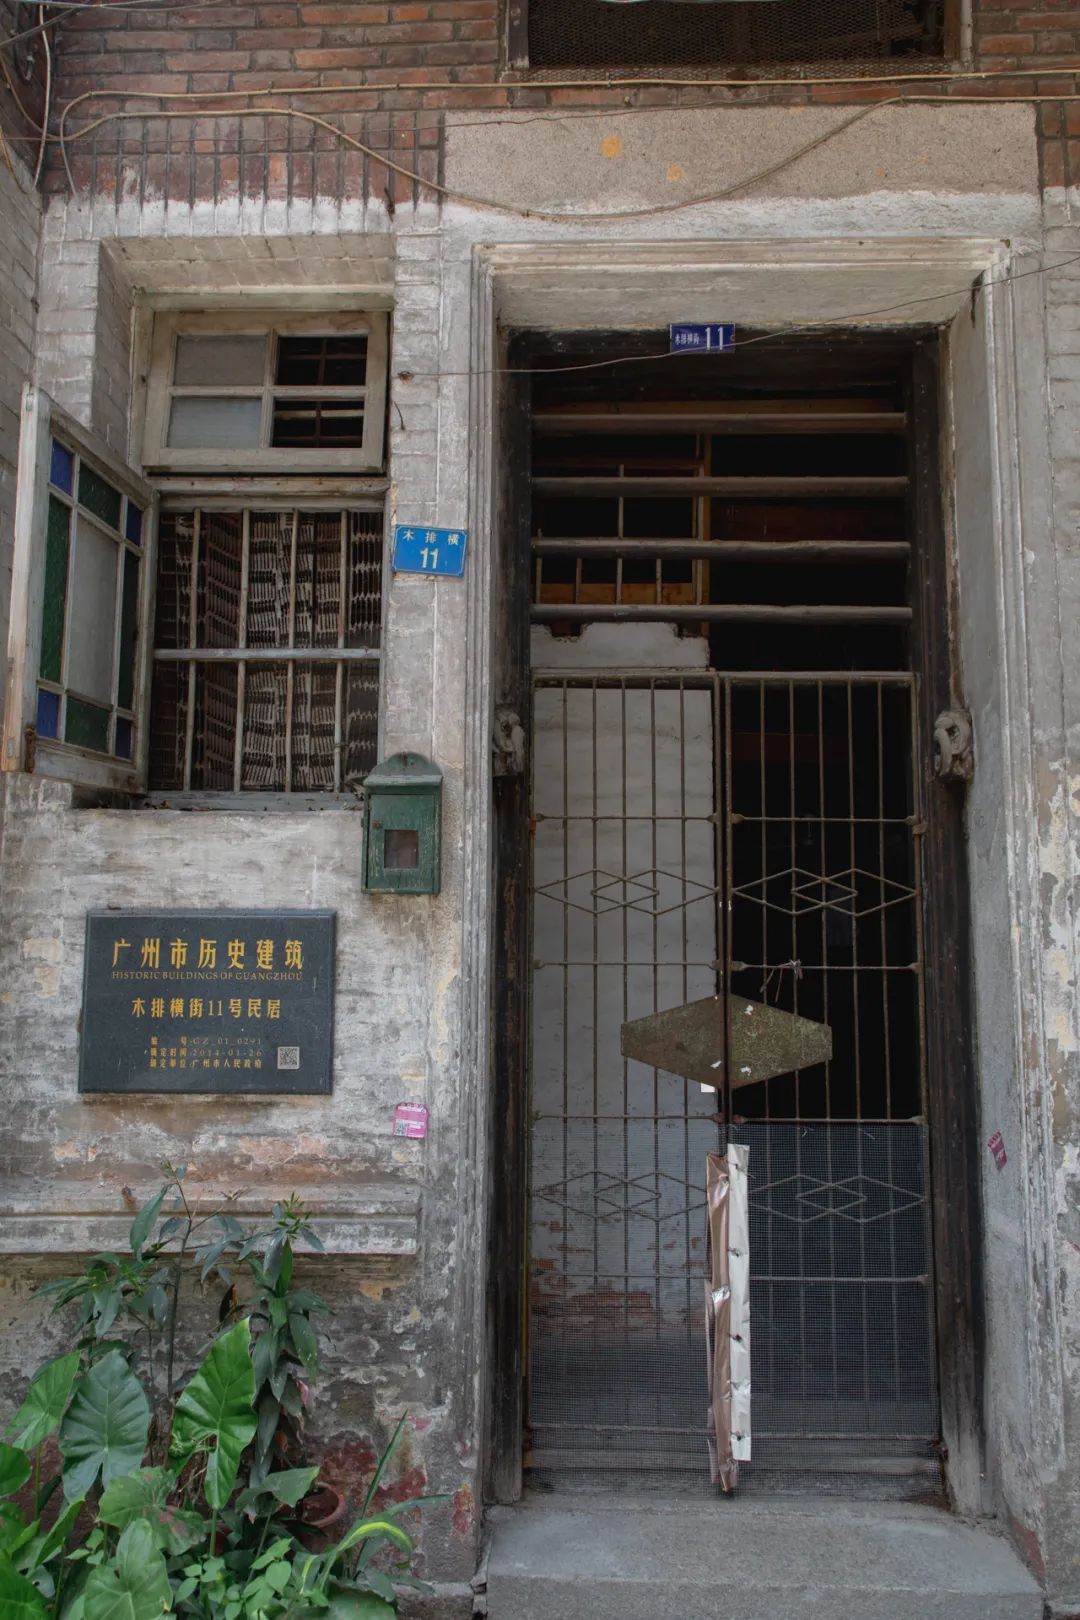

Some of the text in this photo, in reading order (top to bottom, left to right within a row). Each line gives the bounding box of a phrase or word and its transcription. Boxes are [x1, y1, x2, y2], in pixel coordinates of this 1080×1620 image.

[705, 327, 723, 350] 11
[402, 529, 459, 546] 木排横
[420, 547, 439, 569] 11
[112, 938, 303, 970] 广州市历史建筑
[112, 971, 303, 981] HISTORIC BUILDINGS OF GUANGZHOU
[132, 998, 281, 1019] 木排横街11号民居
